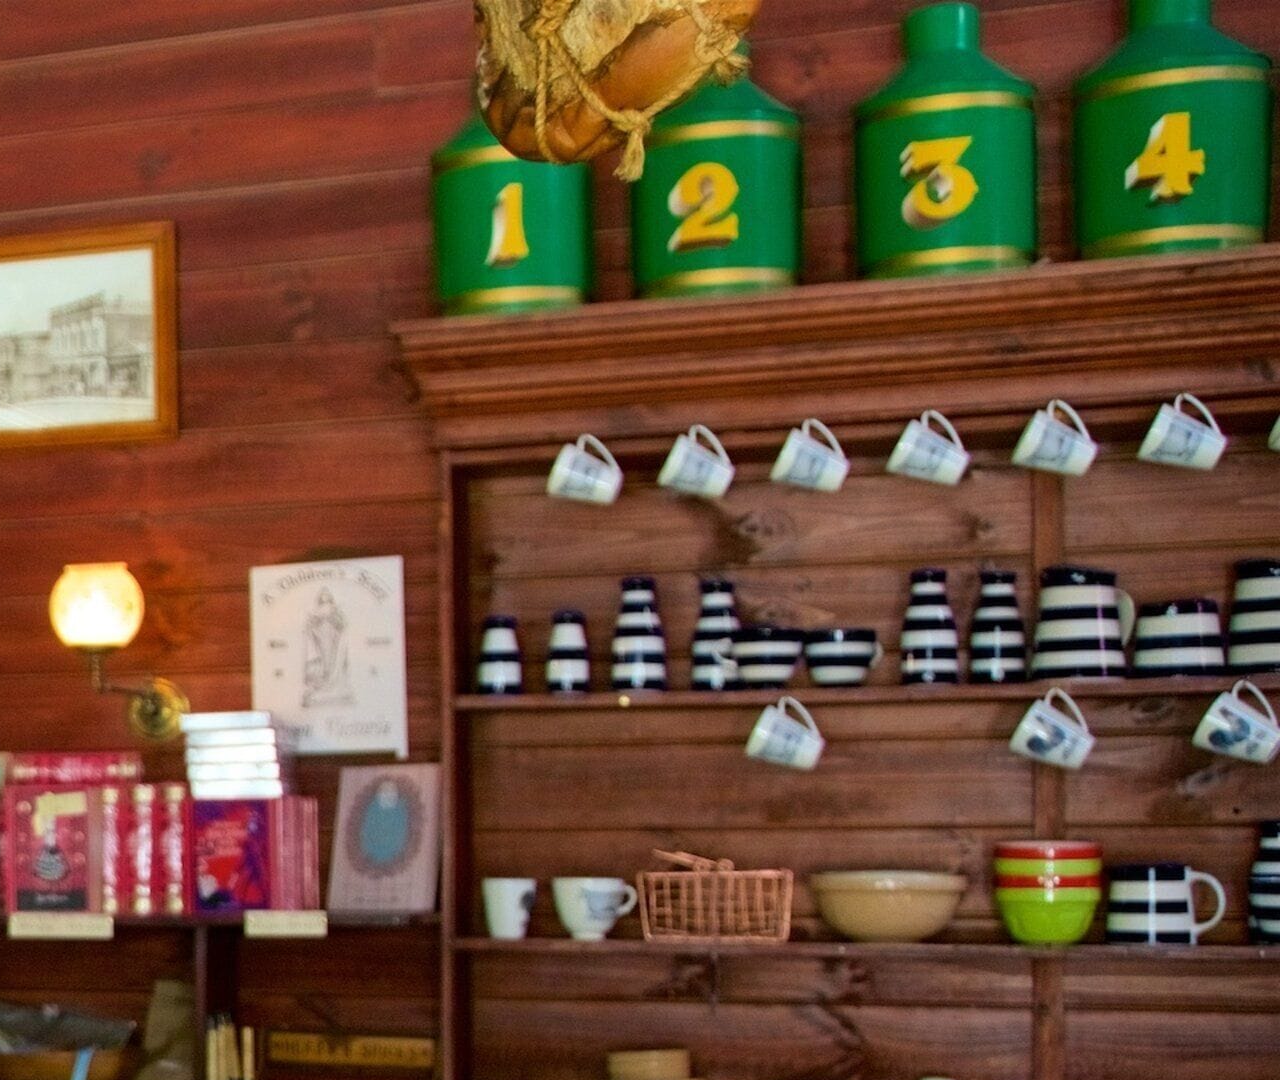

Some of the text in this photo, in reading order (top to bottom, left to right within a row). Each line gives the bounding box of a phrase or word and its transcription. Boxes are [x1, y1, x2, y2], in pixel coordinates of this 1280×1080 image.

[899, 134, 980, 229] 3
[1126, 110, 1206, 204] 4
[485, 182, 529, 267] 1
[666, 161, 740, 252] 2
